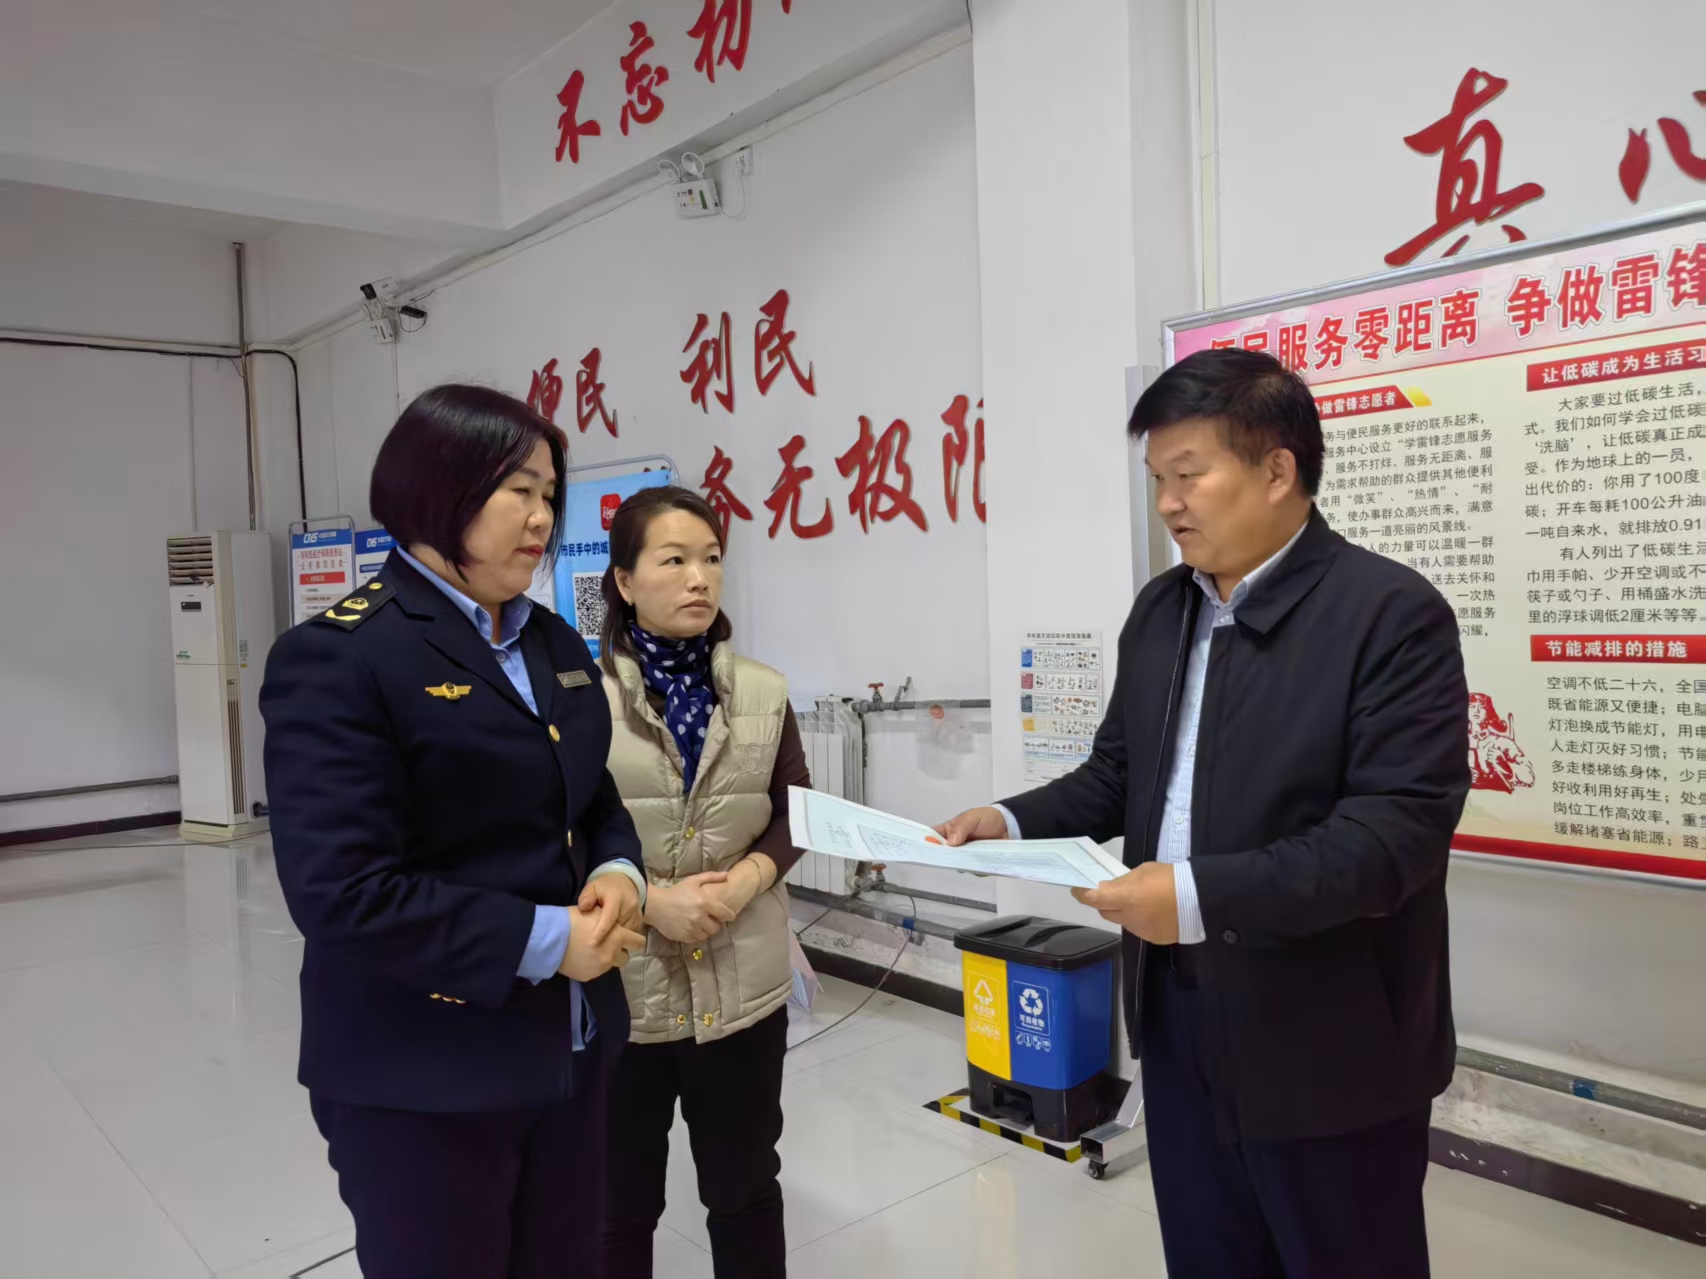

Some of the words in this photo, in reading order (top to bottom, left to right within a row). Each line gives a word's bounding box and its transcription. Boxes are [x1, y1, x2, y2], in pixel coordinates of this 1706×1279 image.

[556, 0, 793, 164] 不忘初
[680, 289, 816, 414] 利民
[1541, 346, 1706, 384] 让低碳成为生活习
[1325, 464, 1493, 491] 为需求帮助的群众提供其他便利
[1525, 469, 1706, 496] 出代价的：你用了100度
[1326, 500, 1493, 524] 务，使办事群众高兴而来，满意
[1525, 494, 1706, 518] 碳；开车每耗100公升油
[1334, 520, 1472, 540] 口服务一道亮丽的风景线。
[1360, 536, 1494, 554] 人的力量可以温暖一群
[1407, 553, 1494, 569] 当有人需要帮助
[1425, 571, 1495, 585] 送去关怀和
[1446, 589, 1495, 602] 一次热
[1452, 606, 1495, 620] 愿服务
[1545, 640, 1688, 659] 节能减排的措施
